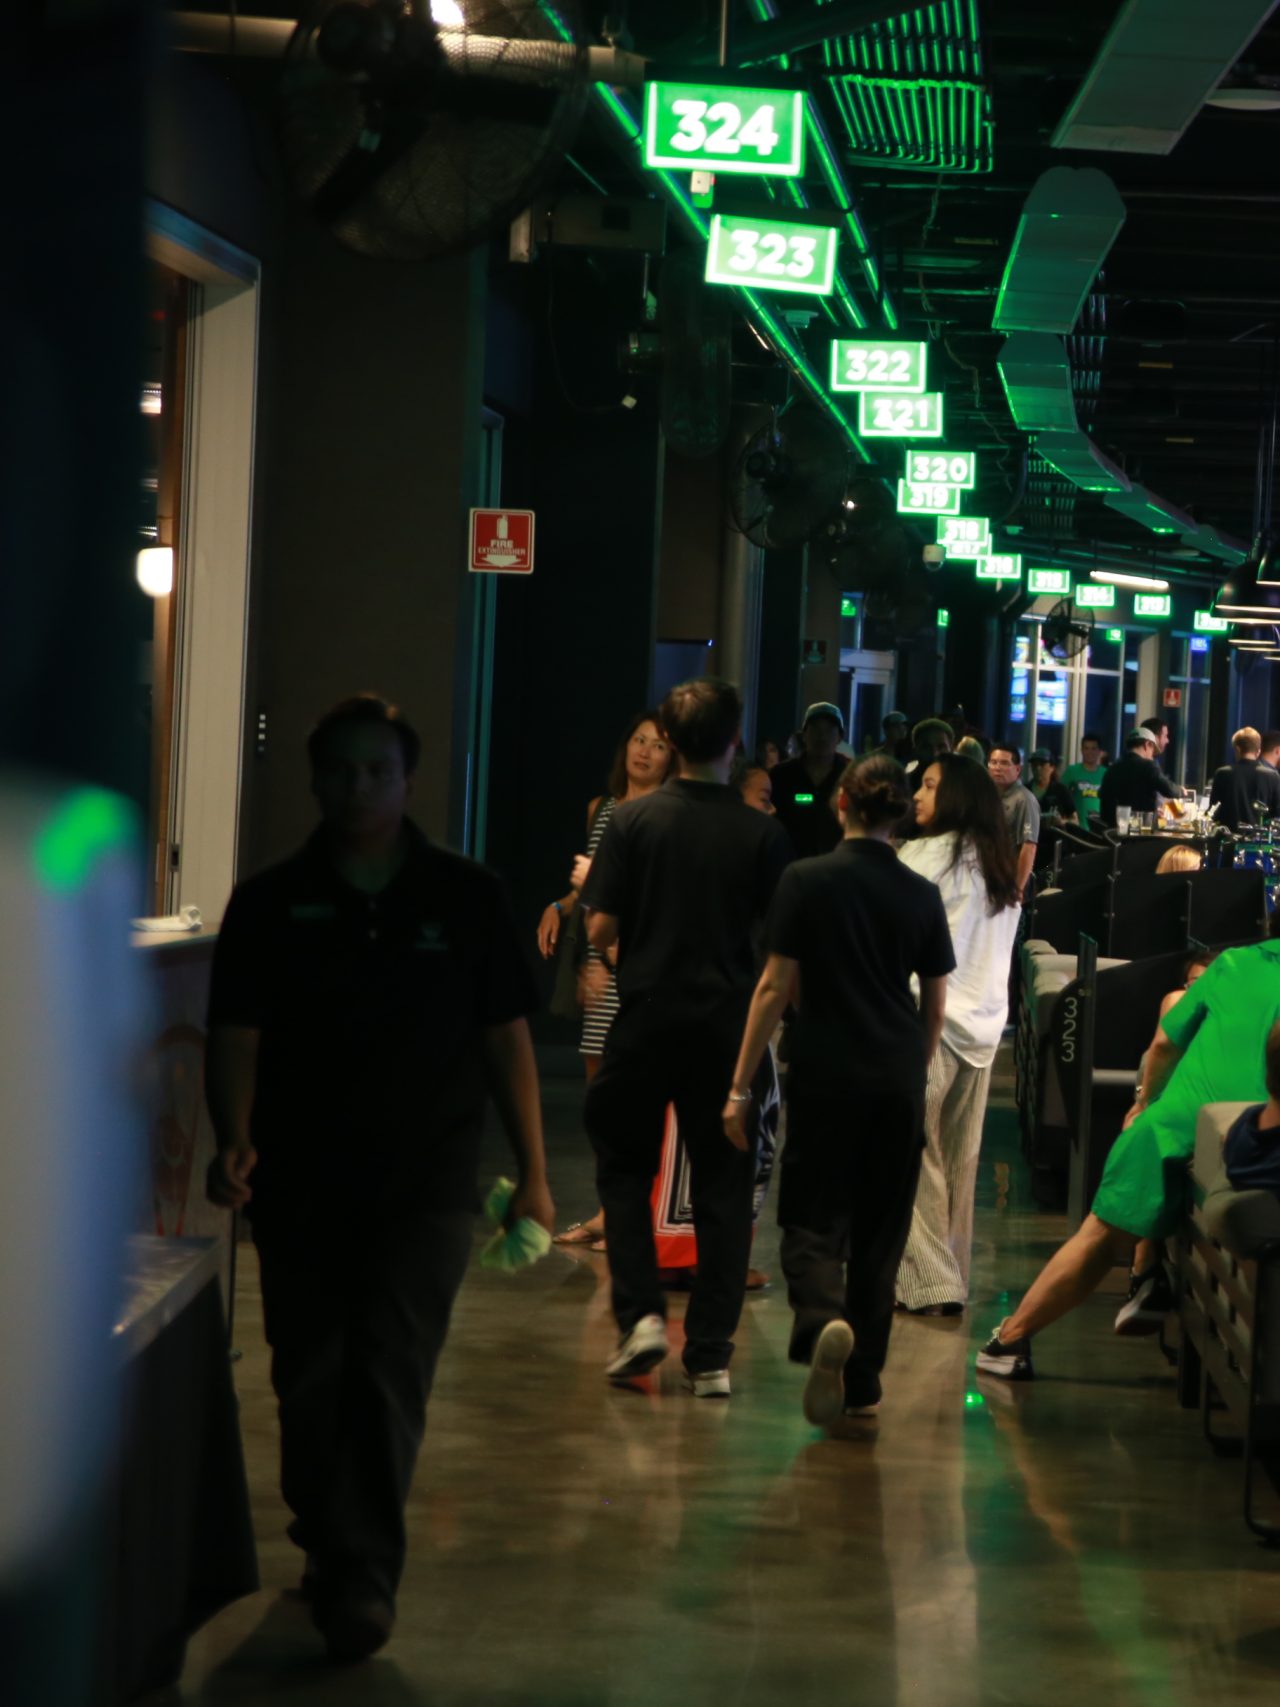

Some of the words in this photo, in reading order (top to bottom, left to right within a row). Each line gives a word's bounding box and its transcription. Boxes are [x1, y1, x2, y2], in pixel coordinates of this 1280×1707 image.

[670, 99, 778, 156] 324
[728, 229, 817, 278] 323
[846, 349, 911, 382] 322
[873, 398, 929, 428] 321
[913, 455, 969, 483] 320
[478, 546, 526, 556] EXTINGUISHER
[490, 539, 513, 549] FIRE
[1060, 996, 1079, 1062] 323
